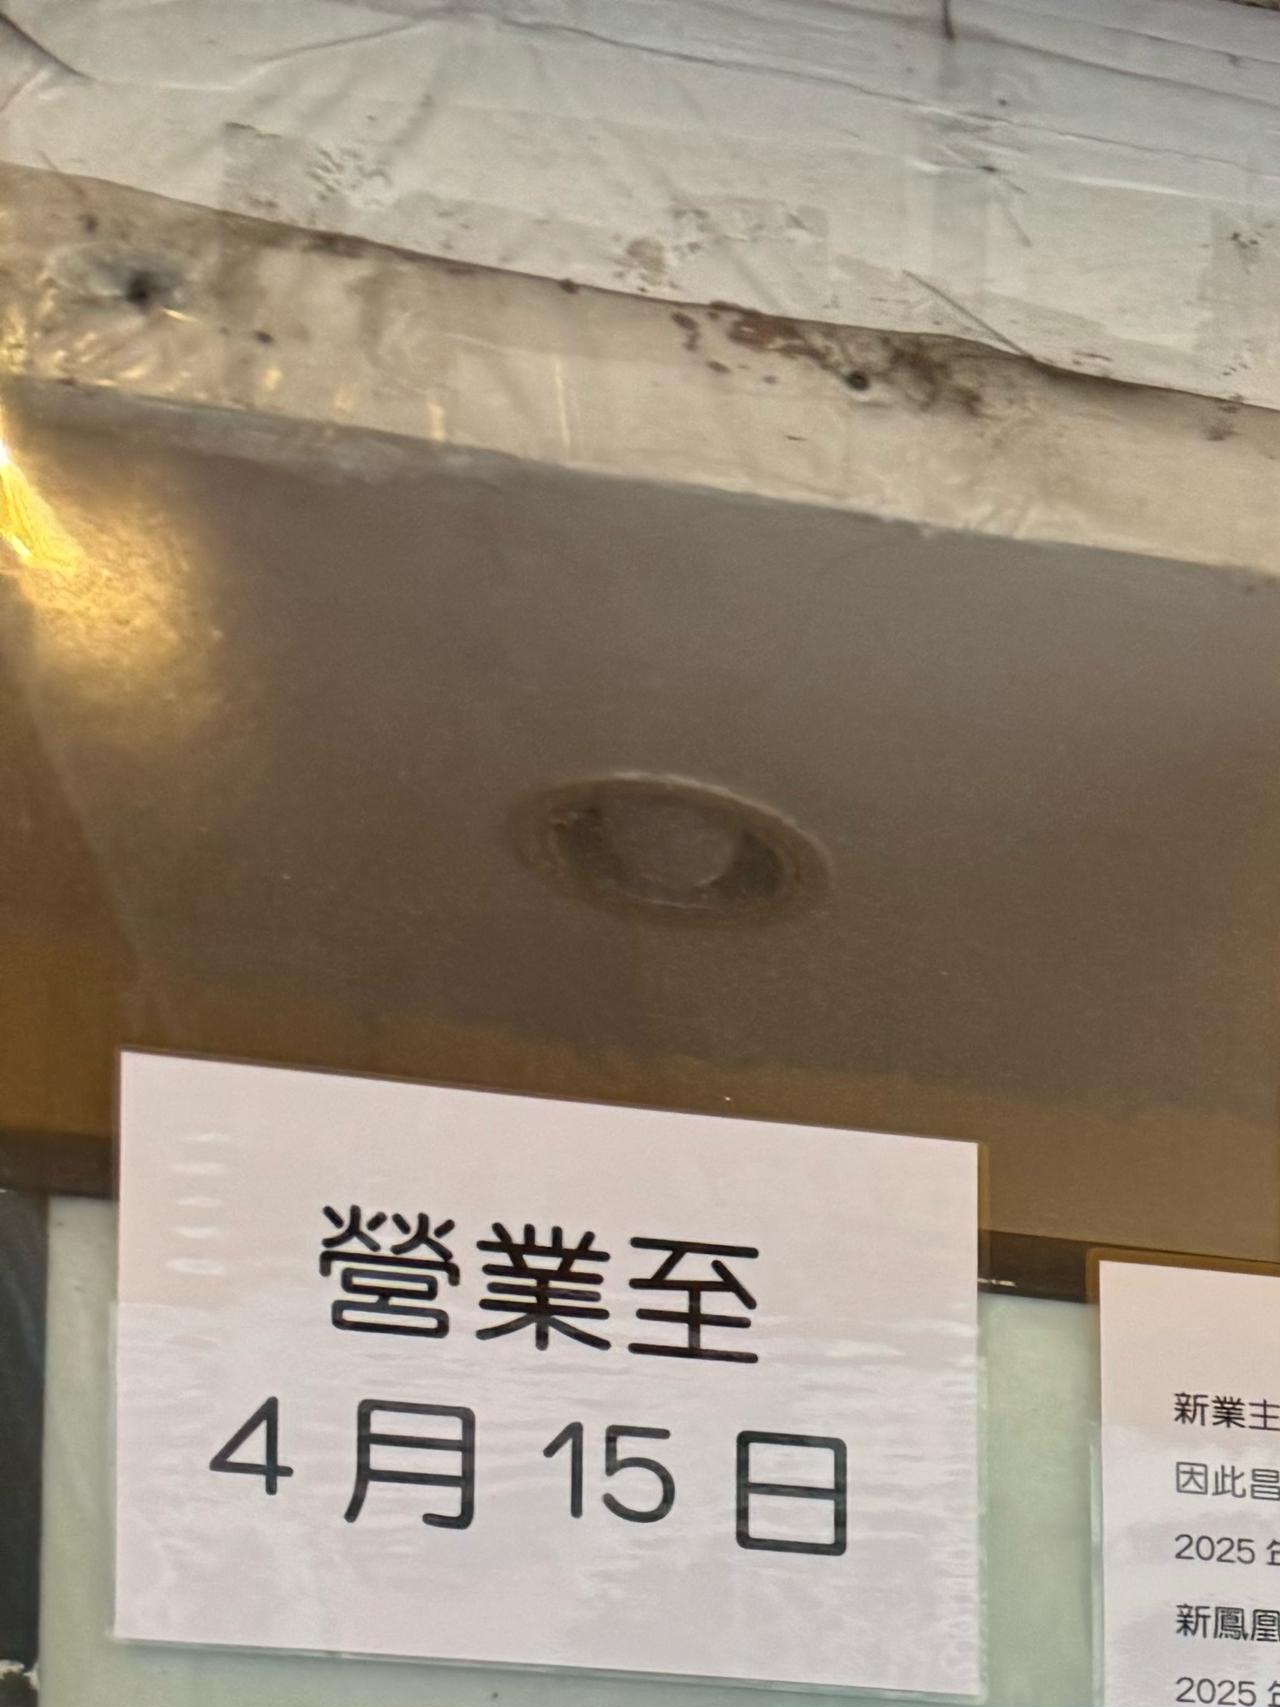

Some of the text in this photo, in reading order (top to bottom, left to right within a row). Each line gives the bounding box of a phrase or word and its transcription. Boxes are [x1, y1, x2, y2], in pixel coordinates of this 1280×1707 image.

[319, 1203, 760, 1364] 營業至
[210, 1396, 847, 1557] 4 月 15 日
[1174, 1534, 1256, 1566] 2025
[1175, 1677, 1257, 1707] 2025
